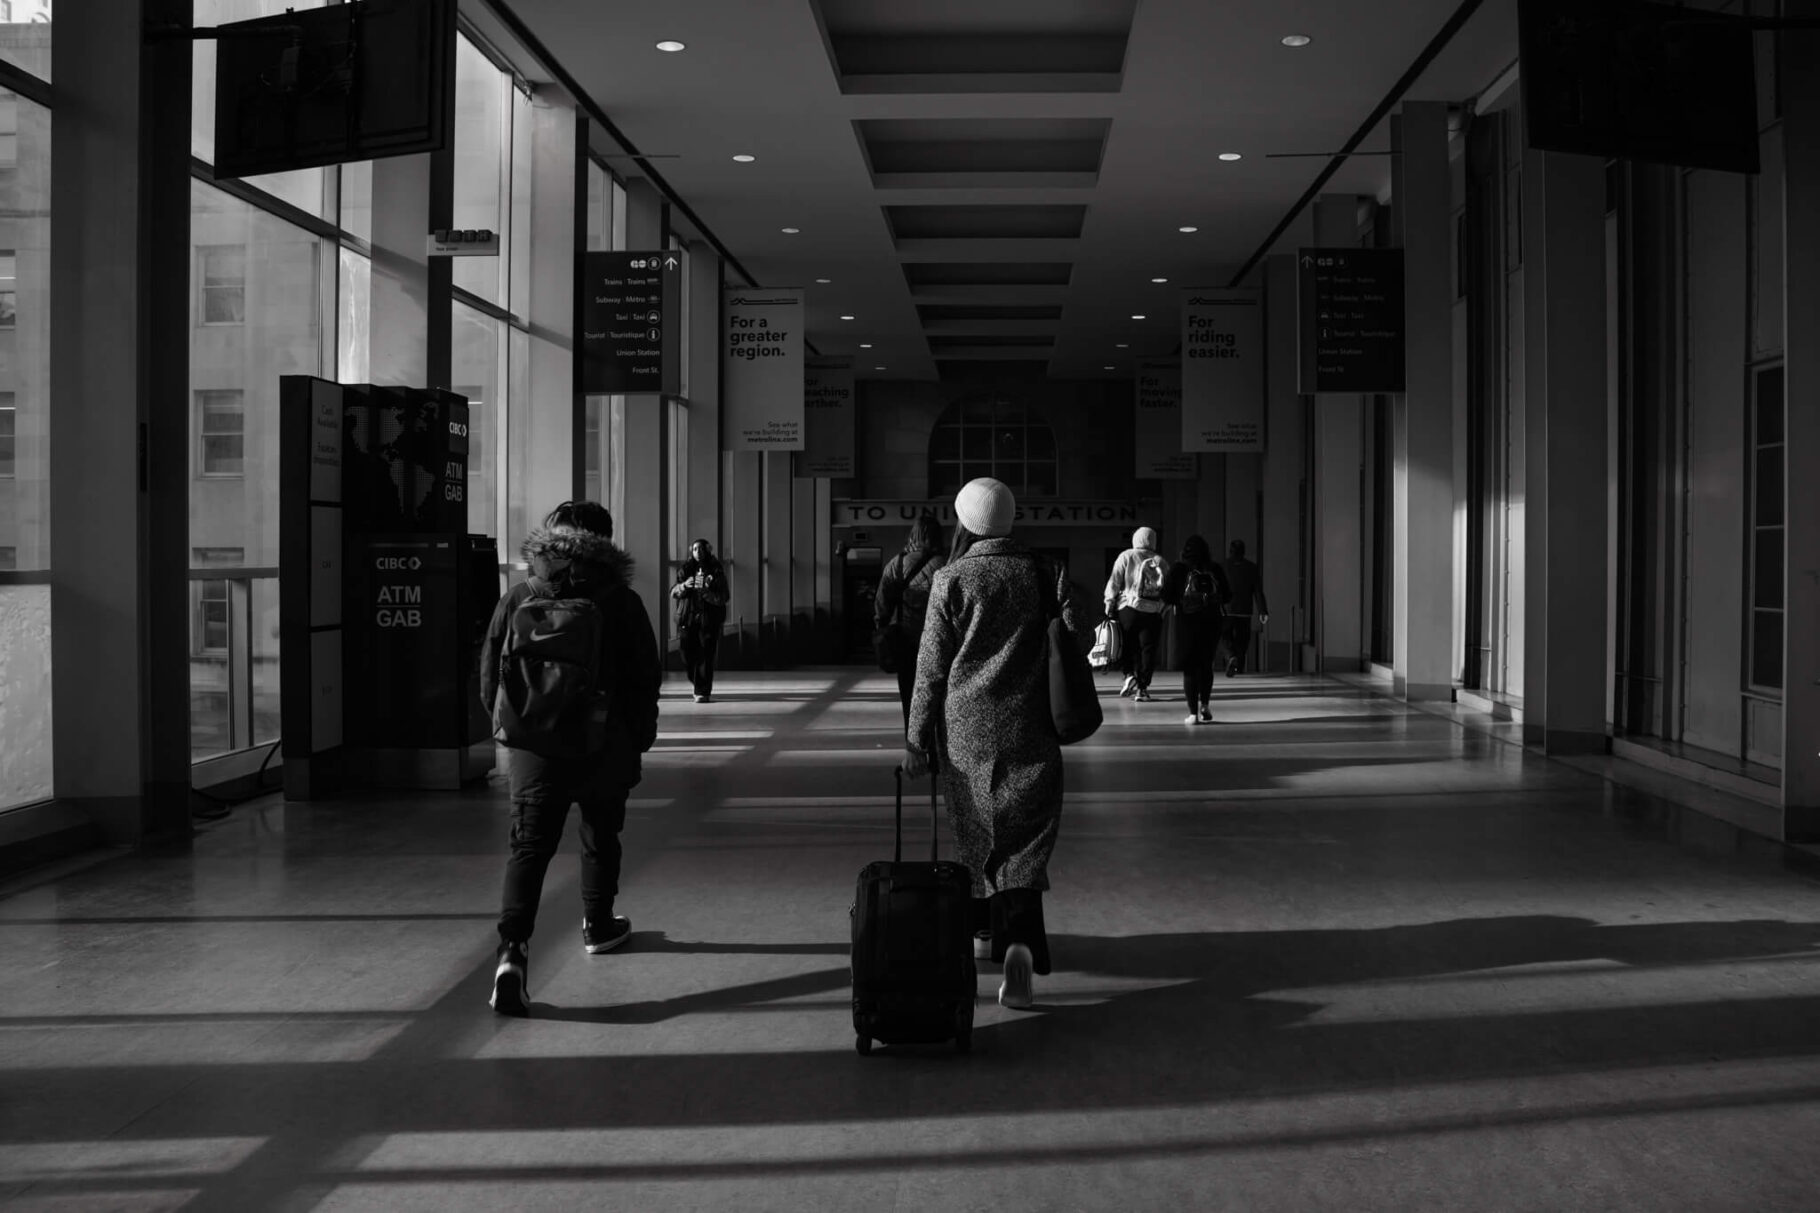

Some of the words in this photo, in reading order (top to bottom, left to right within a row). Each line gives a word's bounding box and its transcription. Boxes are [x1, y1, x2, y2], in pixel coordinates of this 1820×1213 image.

[604, 278, 623, 286] Trains
[627, 278, 646, 286] Trains
[595, 296, 621, 305] Subway
[616, 313, 629, 321] Taxi
[633, 313, 646, 321] Taxi
[730, 315, 756, 328] For
[759, 318, 768, 328] a
[1188, 315, 1214, 328] For
[730, 331, 787, 346] greater
[1188, 330, 1235, 347] riding
[616, 348, 637, 356] Union
[637, 348, 660, 356] Station
[730, 344, 785, 361] region.
[1188, 345, 1240, 359] easier.
[632, 366, 650, 374] Front
[805, 377, 818, 386] or
[1140, 376, 1158, 386] For
[449, 421, 462, 436] CIBC
[762, 428, 790, 436] building
[445, 461, 463, 482] ATM
[445, 484, 463, 502] GAB
[848, 506, 886, 521] TO
[900, 506, 957, 521] UNI
[1014, 506, 1136, 521] STATION
[376, 556, 407, 570] CIBC
[376, 585, 422, 604] ATM
[376, 609, 422, 628] GAB
